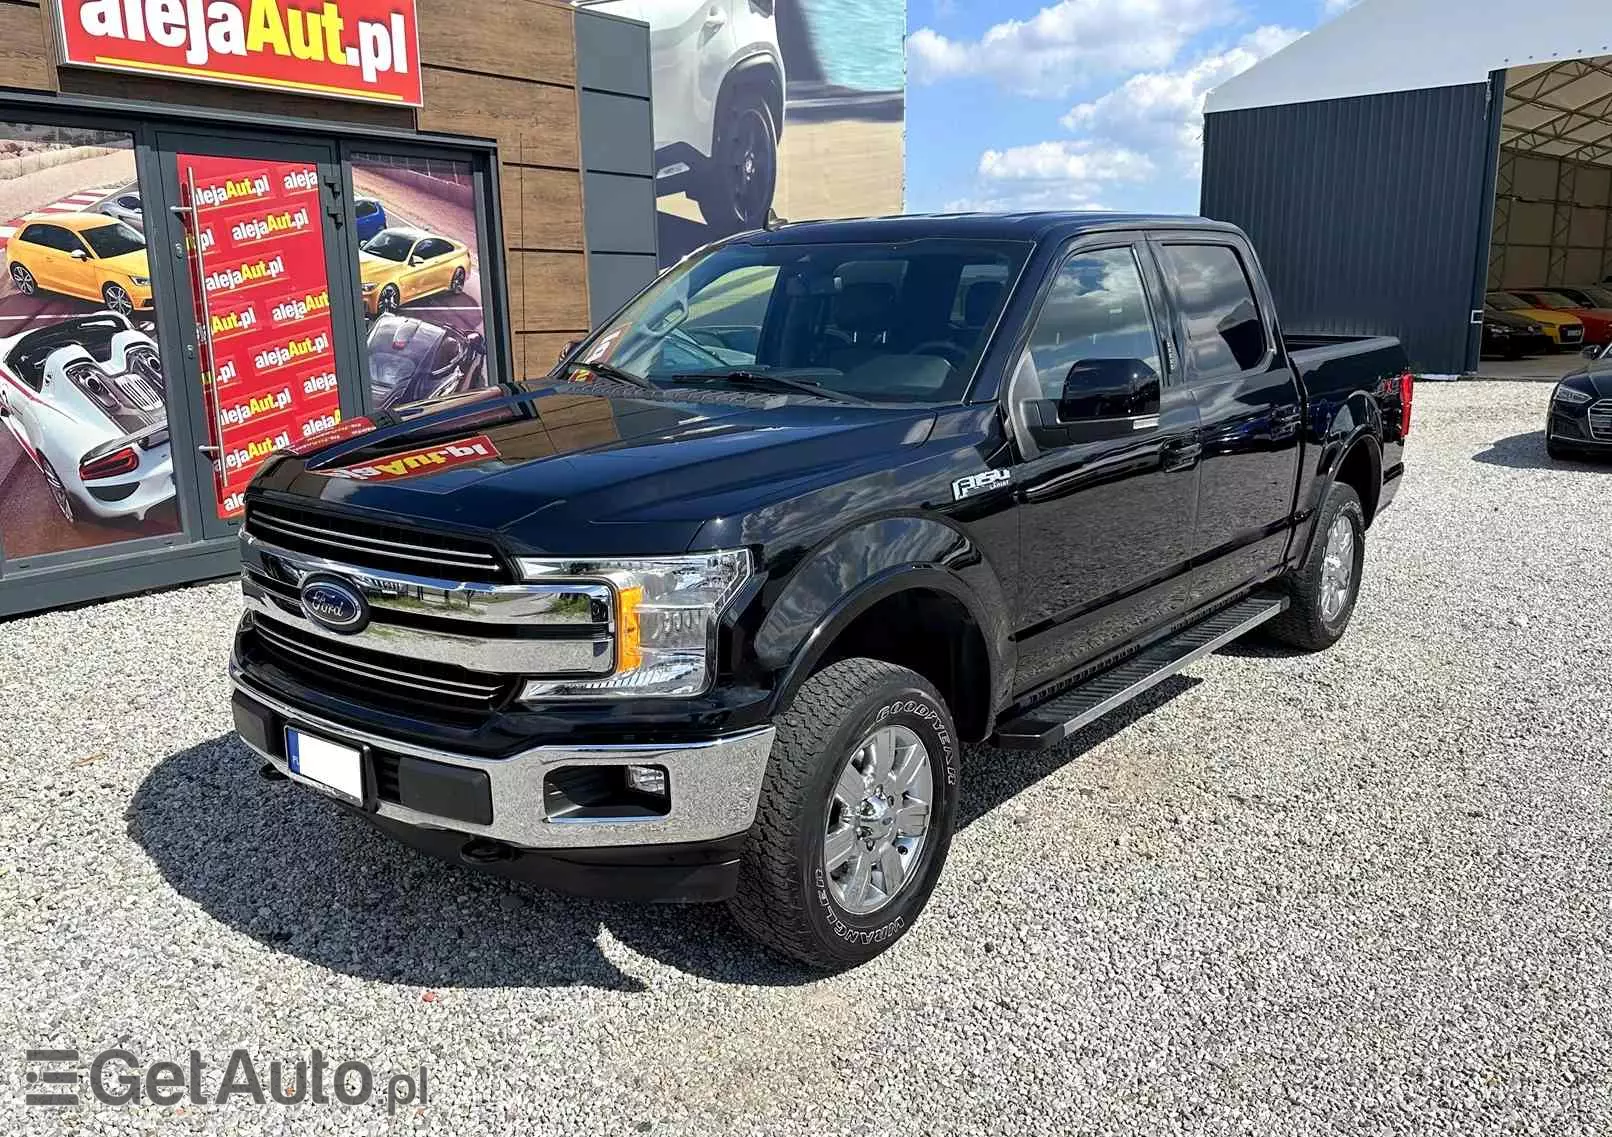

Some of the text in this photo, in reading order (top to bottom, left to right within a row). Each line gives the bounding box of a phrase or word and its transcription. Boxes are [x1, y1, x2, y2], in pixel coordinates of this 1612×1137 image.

[79, 0, 408, 83] alejaAut.pl
[232, 208, 309, 240] alejaAut.pl
[205, 256, 285, 291] alejaAut.pl
[254, 333, 329, 369] alejaAut.pl
[303, 372, 337, 394] aleja
[213, 431, 290, 472] aejaAut.pl
[311, 590, 344, 617] Ford
